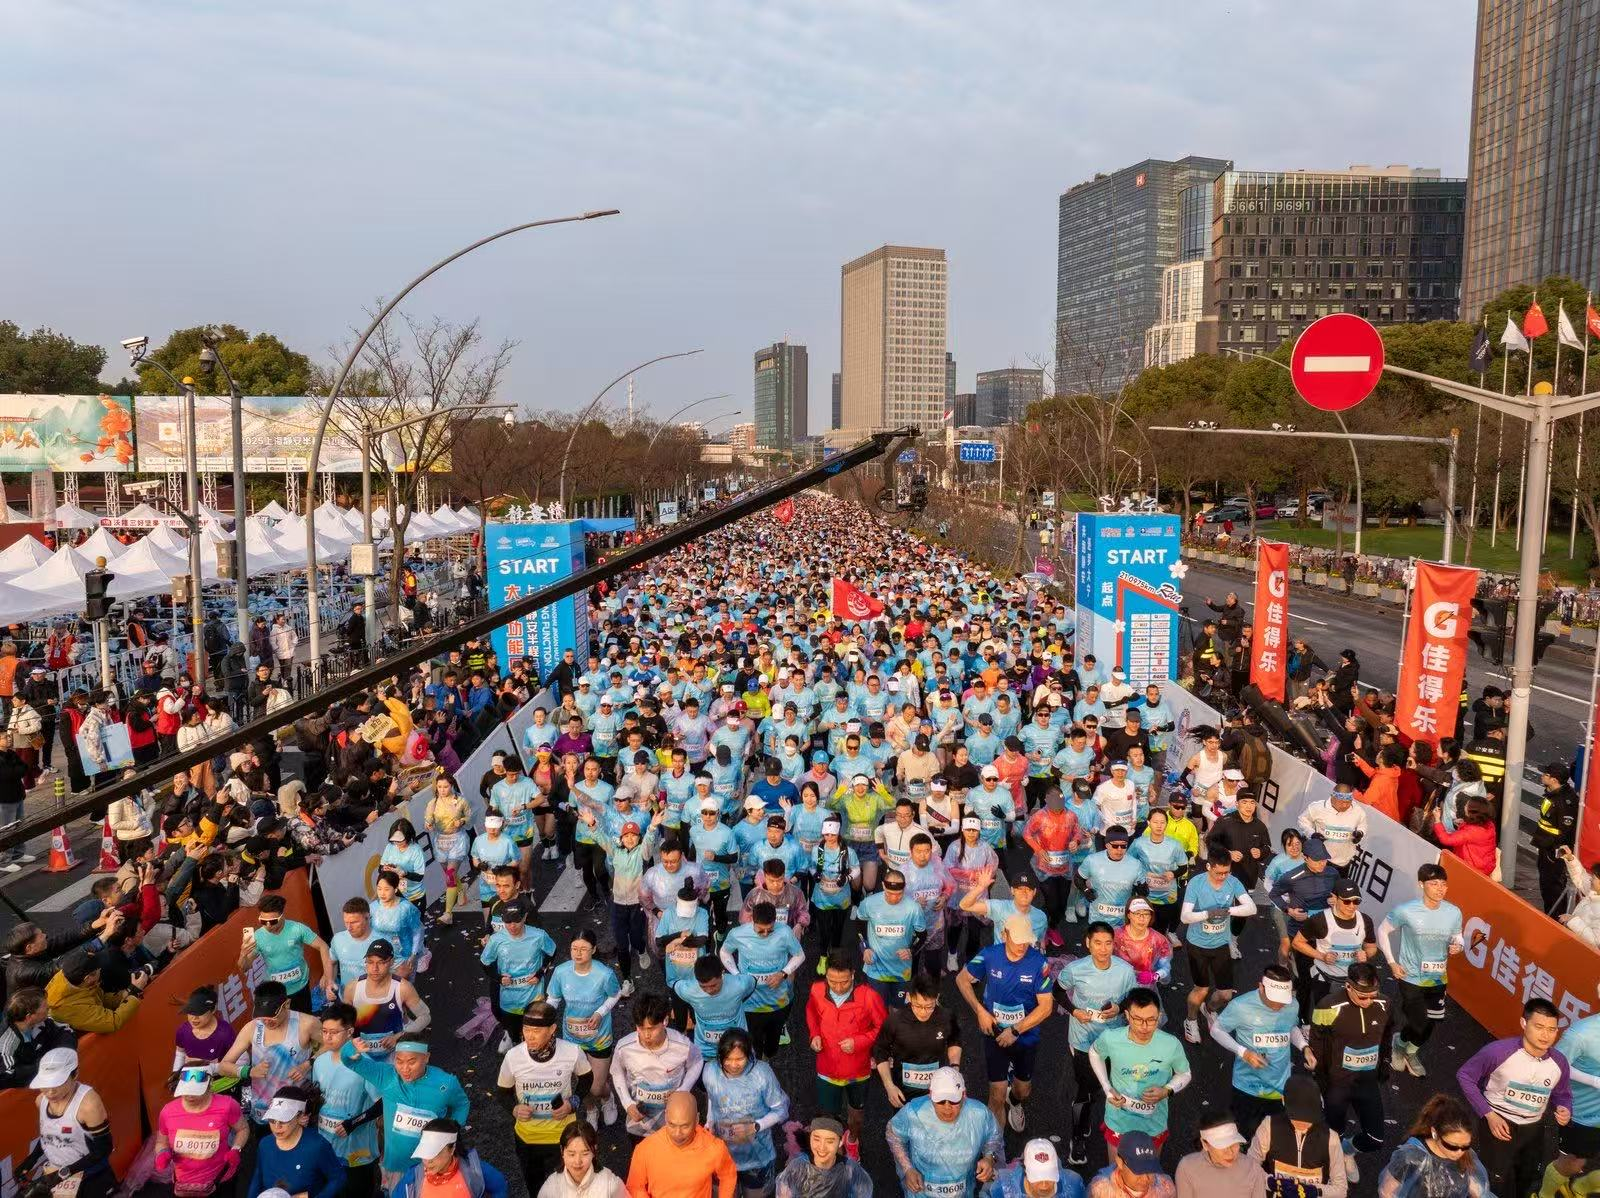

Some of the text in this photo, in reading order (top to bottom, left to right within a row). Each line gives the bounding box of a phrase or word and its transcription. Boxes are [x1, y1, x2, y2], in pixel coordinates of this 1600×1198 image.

[1229, 201, 1311, 211] 5661 9691
[1107, 549, 1168, 564] START
[499, 558, 559, 575] START
[1101, 581, 1114, 607] 起点
[1423, 601, 1459, 639] G
[1258, 601, 1283, 673] 佳得乐
[542, 621, 552, 666] FUNCTION
[1410, 642, 1450, 735] 佳得乐
[1002, 1011, 1024, 1021] 70915
[705, 1031, 711, 1039] D
[1255, 1035, 1288, 1043] D 70530
[904, 1071, 911, 1079] D
[522, 1081, 563, 1091] HUALONG
[1508, 1089, 1515, 1097] D
[1130, 1101, 1156, 1112] 70055
[396, 1114, 403, 1123] D
[176, 1139, 217, 1150] D 80176
[937, 1183, 965, 1194] 30608
